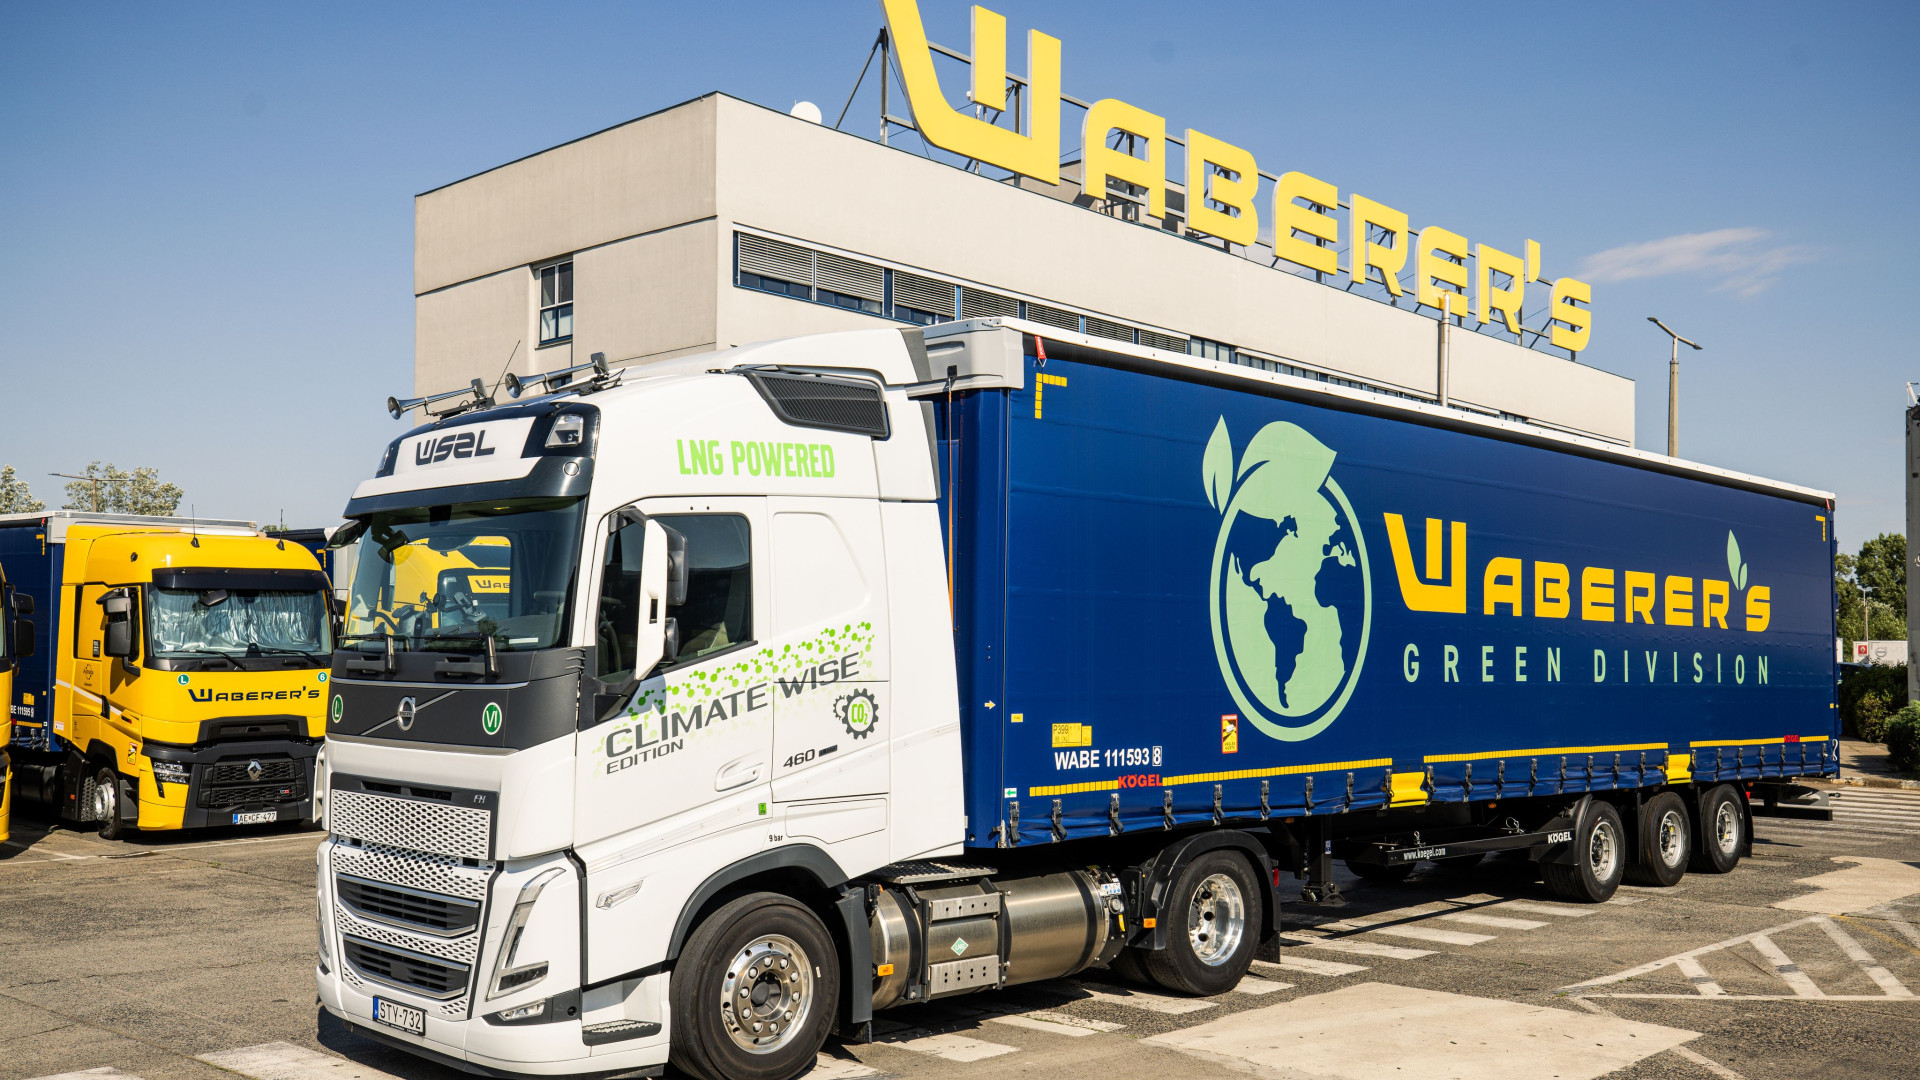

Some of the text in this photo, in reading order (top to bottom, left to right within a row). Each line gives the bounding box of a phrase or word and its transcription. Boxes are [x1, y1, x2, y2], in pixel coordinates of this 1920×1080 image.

[882, 0, 1591, 352] WABERER'S
[677, 438, 835, 479] LNG POWERED
[1383, 512, 1771, 632] WABERER'S
[1403, 643, 1769, 685] GREEN DIVISION
[187, 686, 320, 703] WABERER'S
[606, 651, 860, 758] CLIMATE WISE
[485, 710, 498, 728] VI
[606, 738, 684, 775] EDITION
[783, 748, 815, 767] 460
[1054, 747, 1161, 770] WABE 111593 8
[1117, 774, 1163, 789] KÖGEL
[473, 794, 487, 804] FH
[769, 834, 783, 842] 9 bar
[1547, 831, 1572, 844] KÖGEL
[1403, 847, 1446, 861] www.koegel.com
[380, 1002, 421, 1030] STY-732
